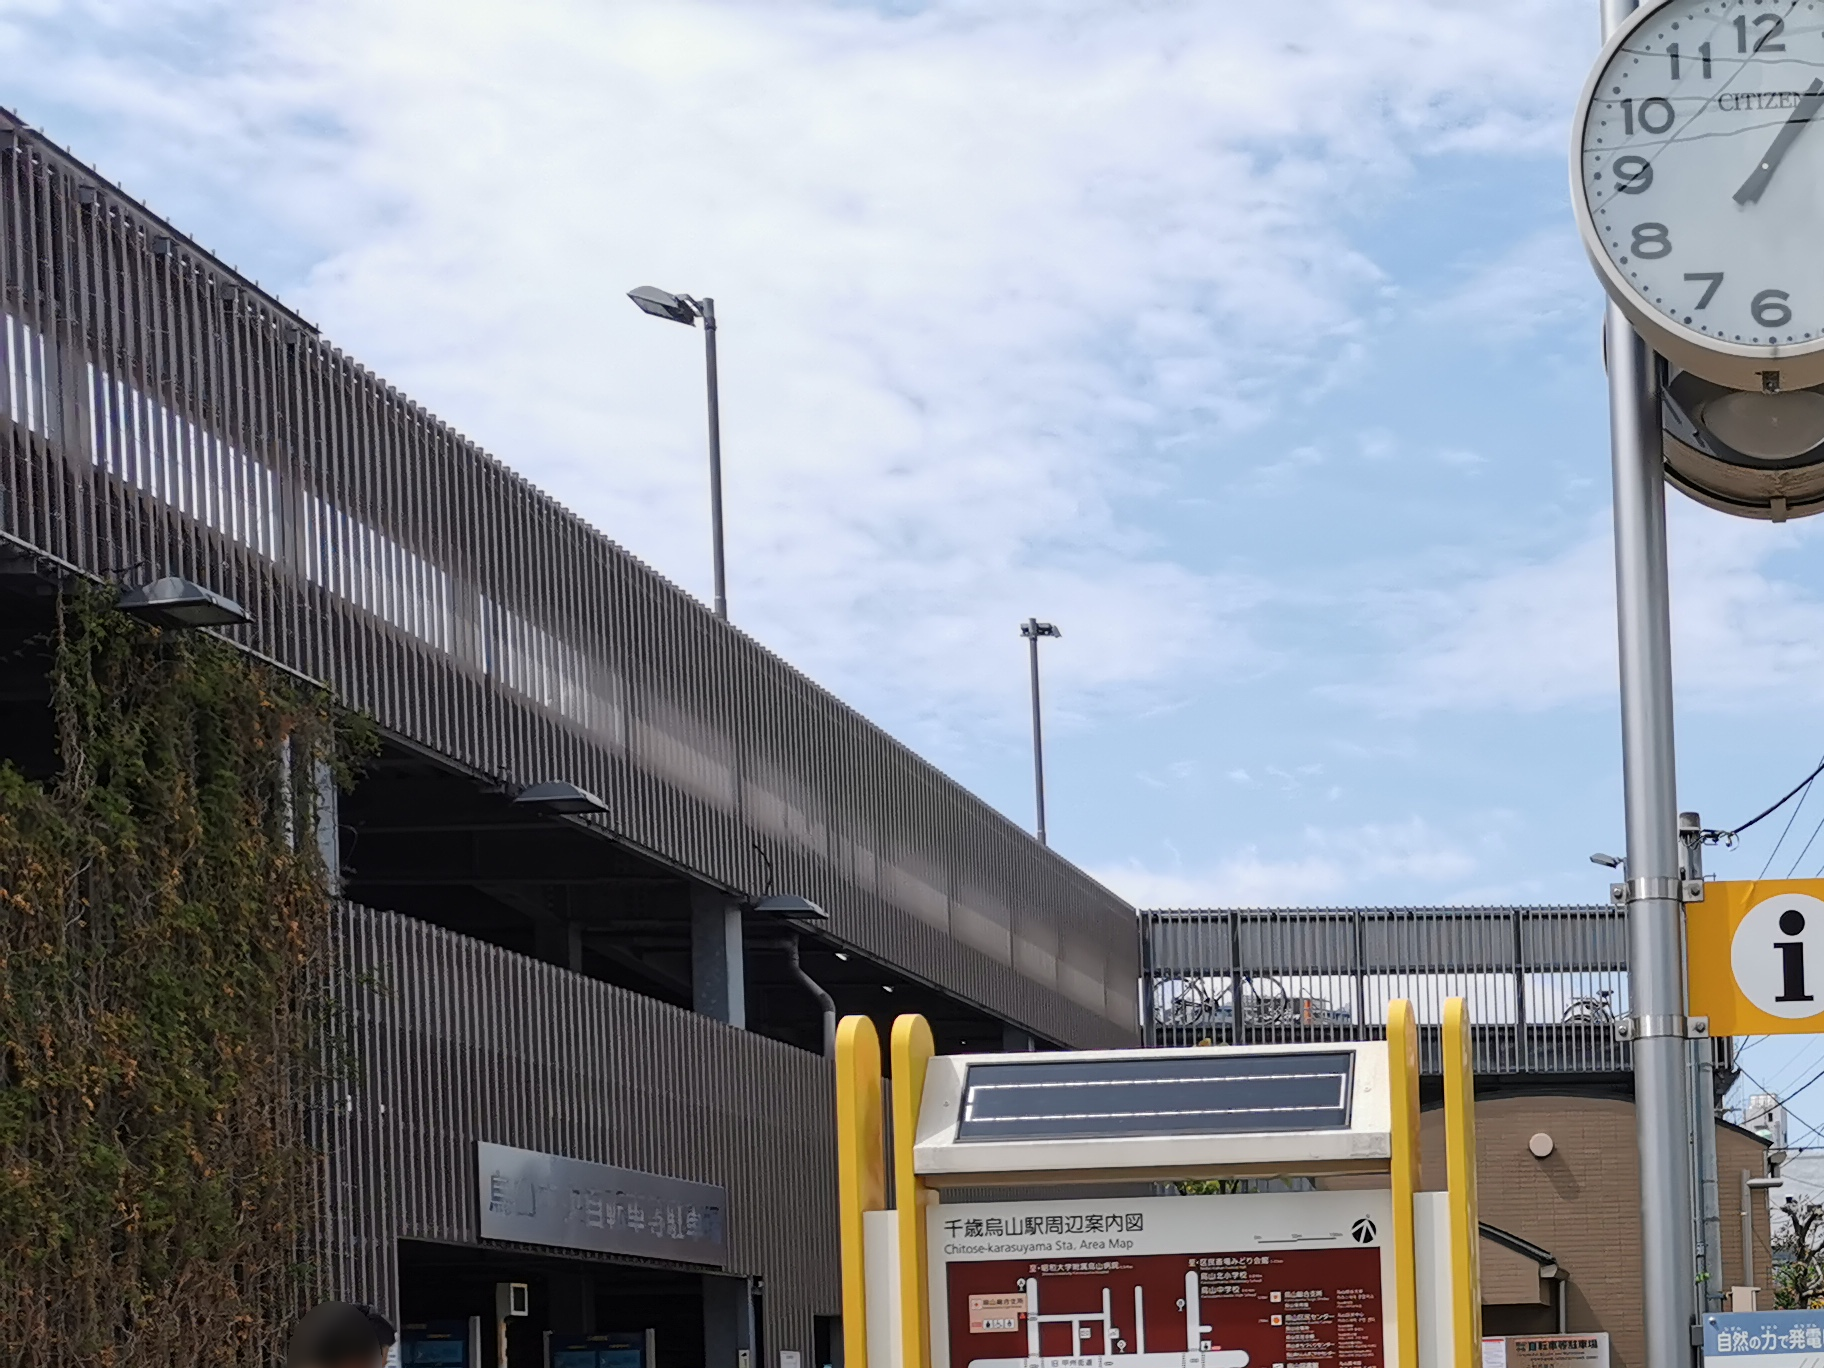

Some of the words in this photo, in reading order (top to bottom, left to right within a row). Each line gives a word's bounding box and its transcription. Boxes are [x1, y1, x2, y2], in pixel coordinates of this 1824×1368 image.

[1733, 14, 1786, 53] 12
[1667, 42, 1712, 80] 11
[1620, 97, 1676, 135] 10
[1613, 156, 1654, 195] 9
[1631, 222, 1672, 260] 8
[1684, 272, 1725, 311] 7
[1751, 289, 1792, 328] 6
[943, 1213, 1144, 1238] 千歳烏山駅周辺案内図
[944, 1242, 1053, 1255] Chitose-karasuyama
[1079, 1239, 1106, 1250] Area
[1109, 1239, 1134, 1250] Map
